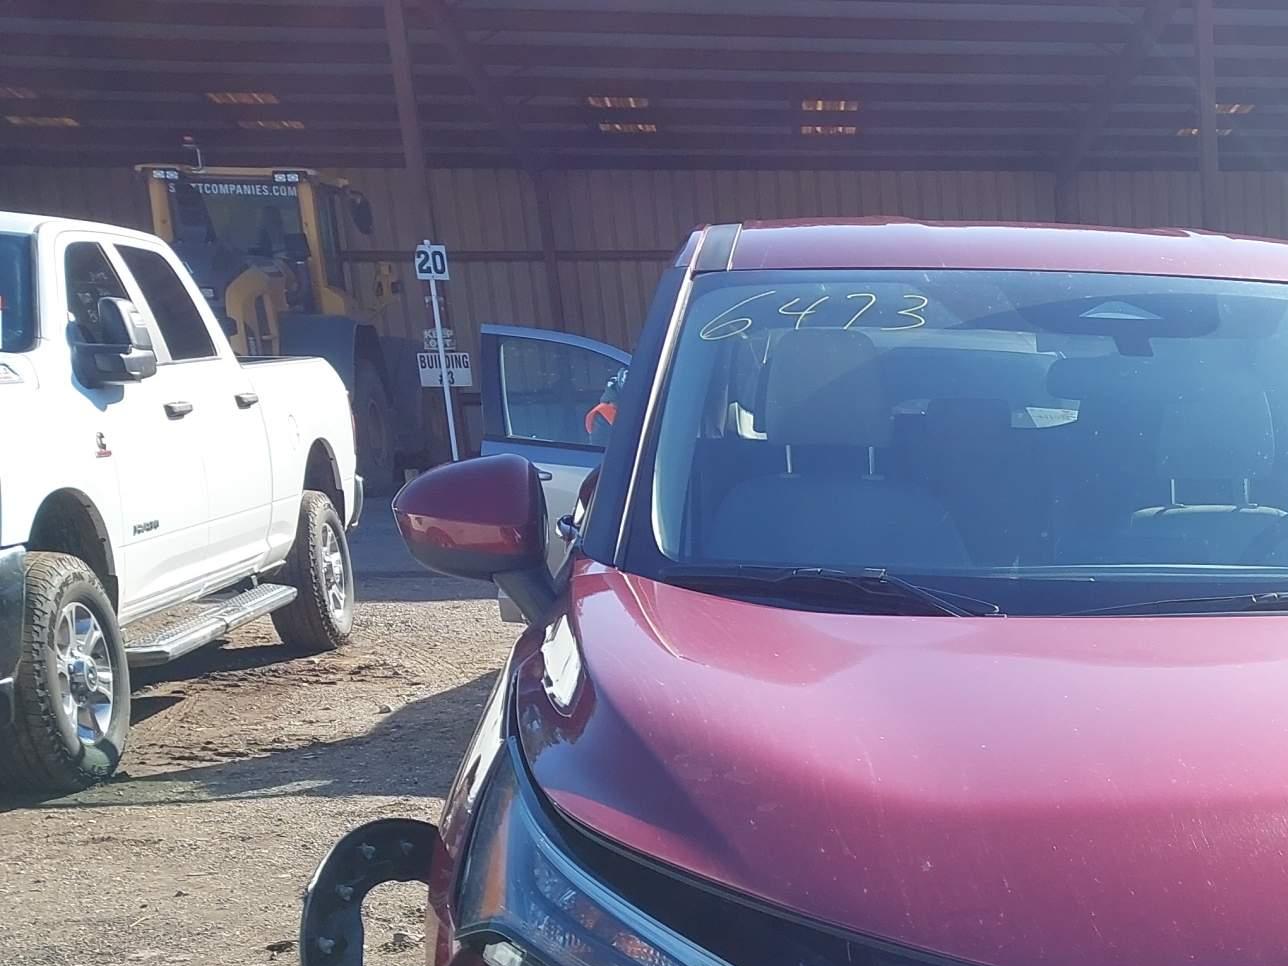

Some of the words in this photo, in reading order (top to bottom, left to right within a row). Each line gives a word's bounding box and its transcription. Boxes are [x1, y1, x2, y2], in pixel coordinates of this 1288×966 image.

[416, 250, 446, 275] 20
[699, 290, 928, 341] 6473
[429, 338, 452, 348] OT
